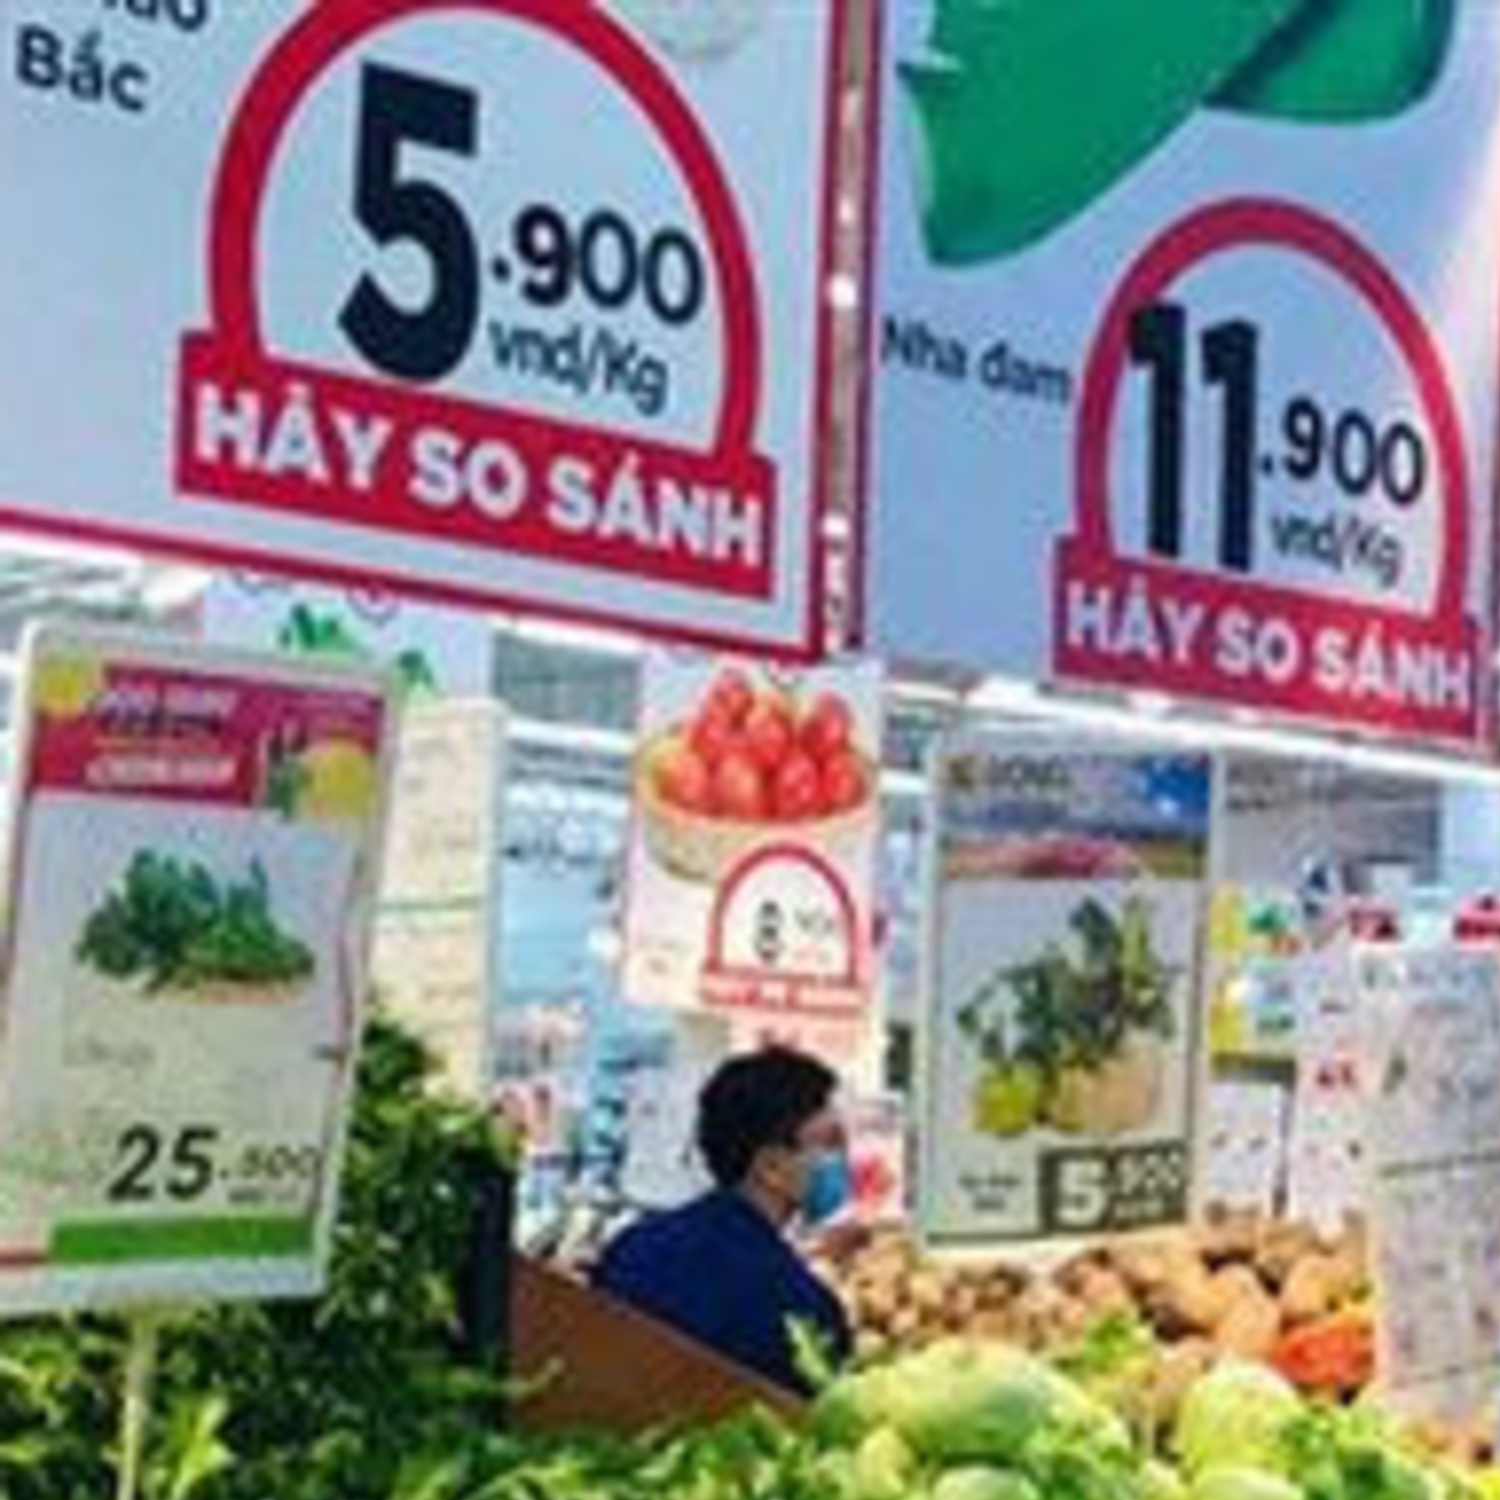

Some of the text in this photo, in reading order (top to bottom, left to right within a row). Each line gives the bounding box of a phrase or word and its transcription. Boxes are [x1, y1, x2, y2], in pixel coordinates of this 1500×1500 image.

[16, 23, 149, 113] Bắc
[410, 428, 528, 520] SO
[546, 447, 764, 568] SÁNH
[1213, 605, 1300, 685] SO
[1313, 620, 1471, 712] SÁNH
